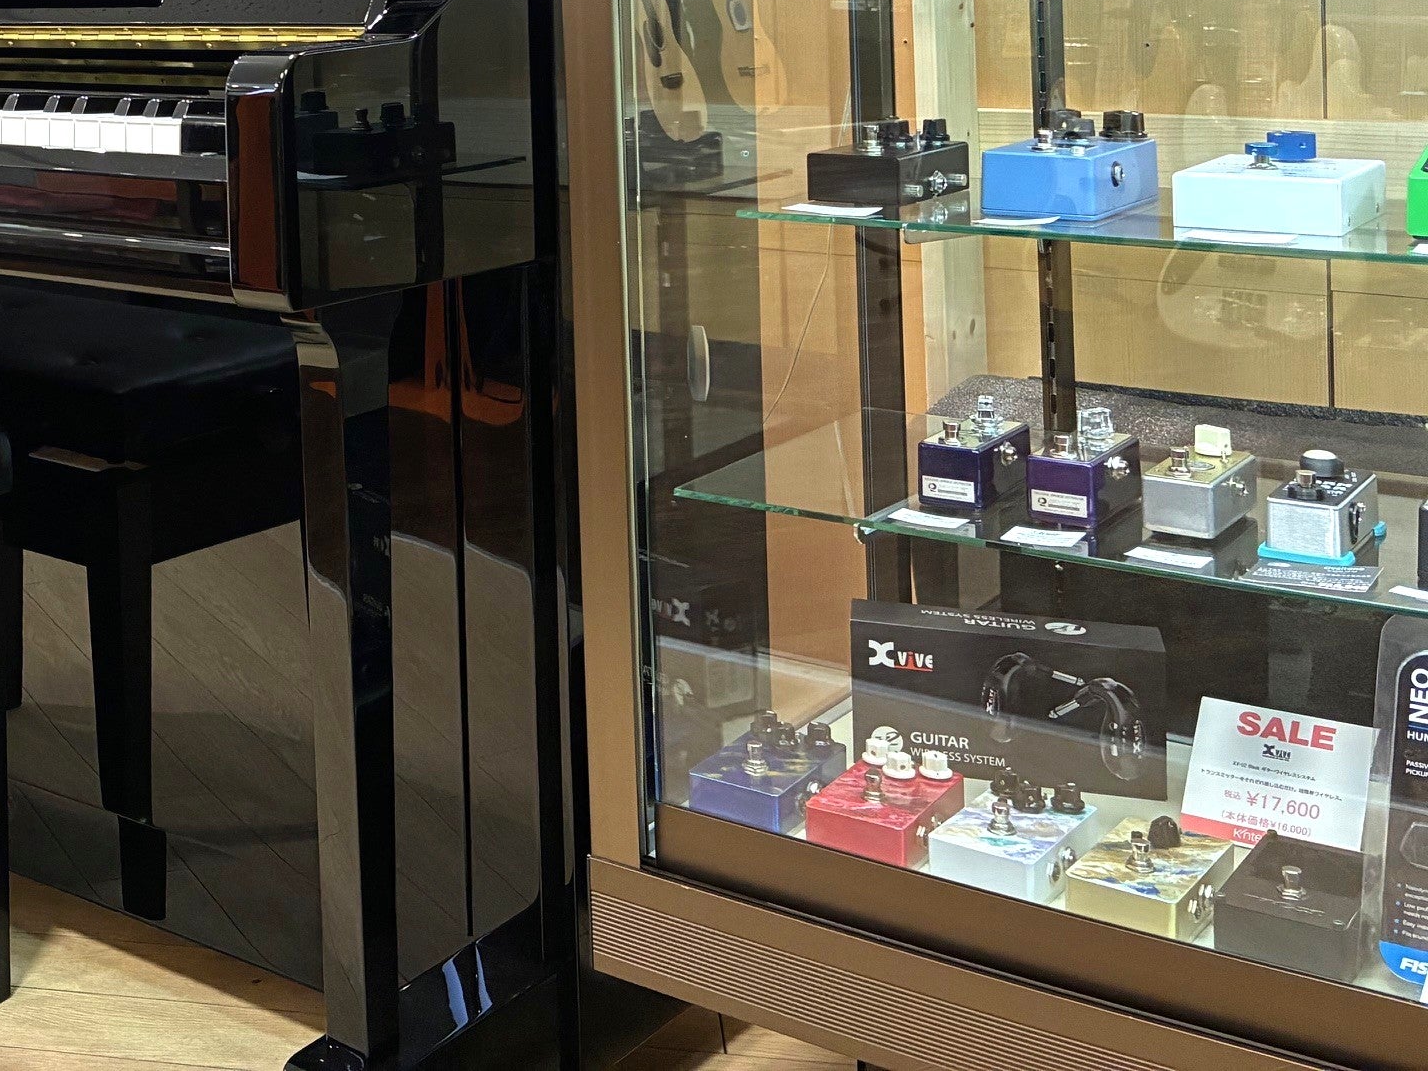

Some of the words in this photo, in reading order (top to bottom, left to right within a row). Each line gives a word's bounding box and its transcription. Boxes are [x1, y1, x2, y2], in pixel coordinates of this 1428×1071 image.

[1408, 668, 1428, 725] NEO
[910, 731, 970, 749] GUITAR
[1237, 711, 1337, 751] SALE
[963, 753, 1006, 767] SYSTEM
[1223, 789, 1241, 800] 税込
[1246, 790, 1321, 820] ¥17,600
